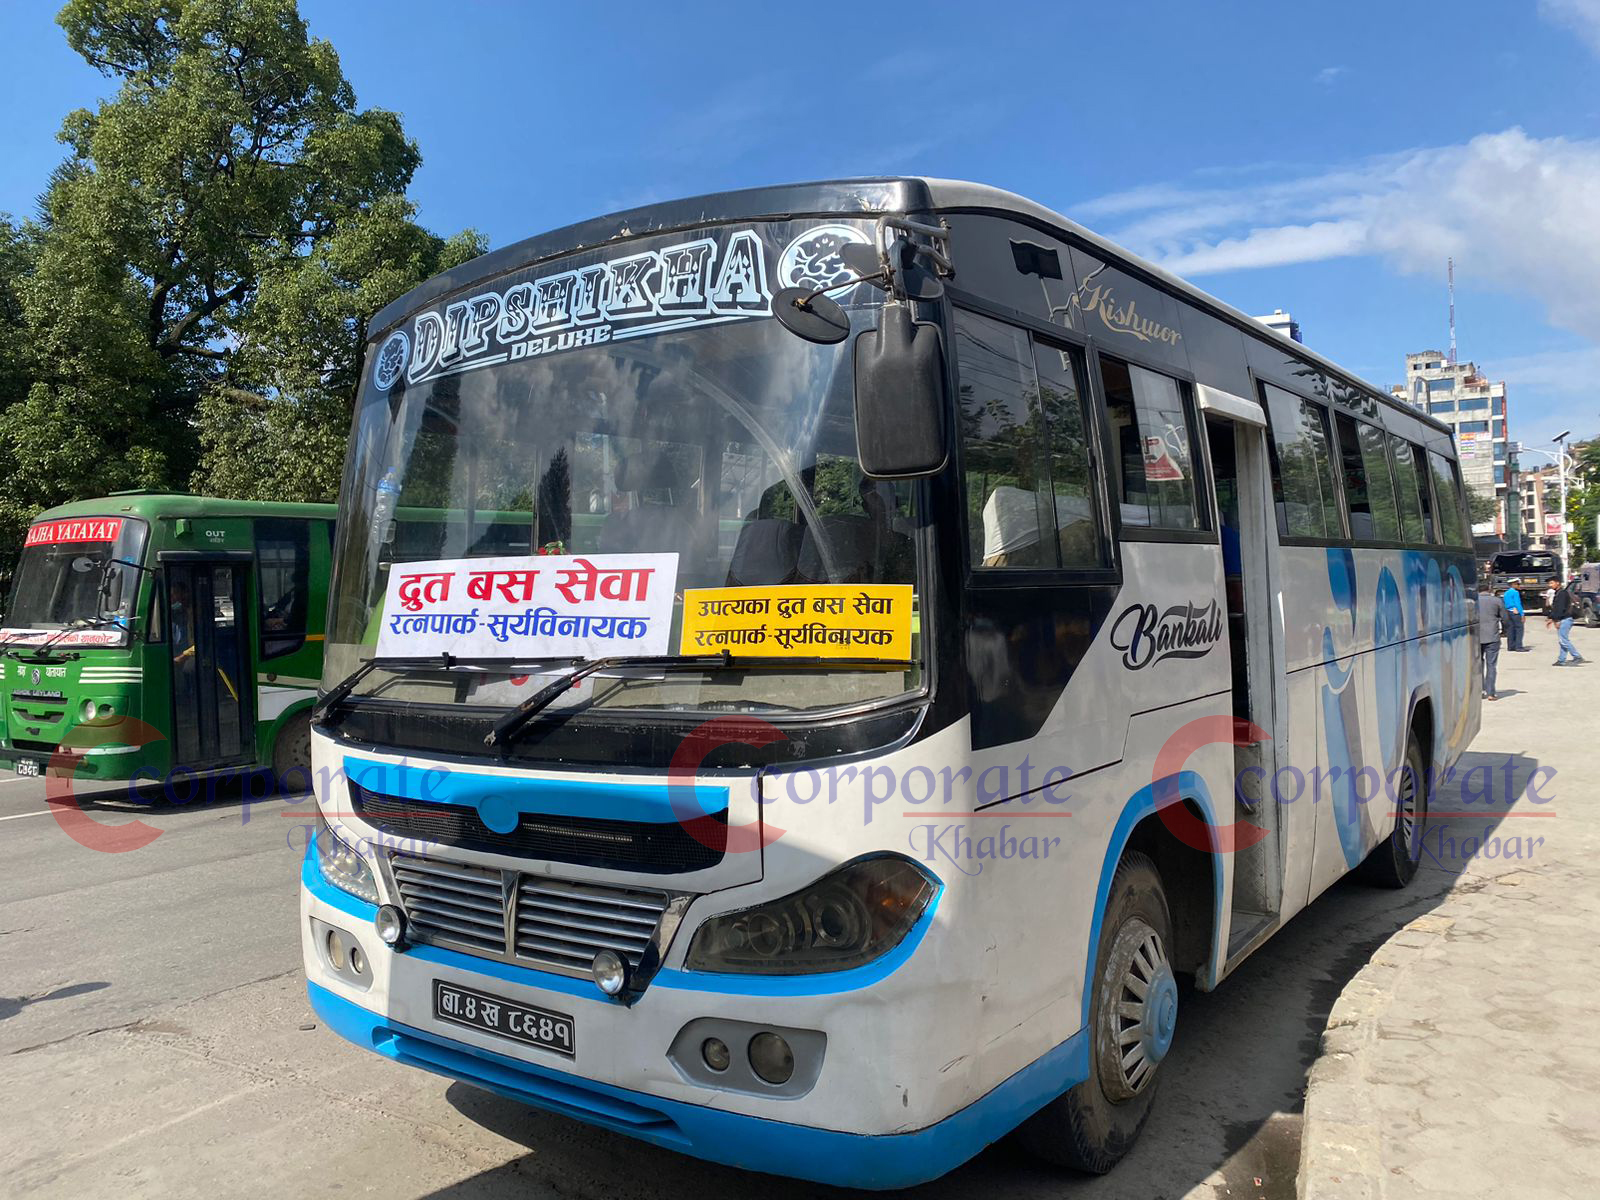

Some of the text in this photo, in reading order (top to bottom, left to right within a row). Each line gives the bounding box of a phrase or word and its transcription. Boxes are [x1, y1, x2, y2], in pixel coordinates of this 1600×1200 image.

[407, 229, 774, 384] DIPSHIKHA
[510, 324, 612, 361] DELUXE
[56, 521, 119, 541] YATAYAT
[205, 530, 226, 538] OUT
[399, 558, 656, 612] द्रुत बस सेवा
[698, 592, 894, 619] उपत्यका द्रुत बस सेवा
[507, 1011, 570, 1047] ८६४१
